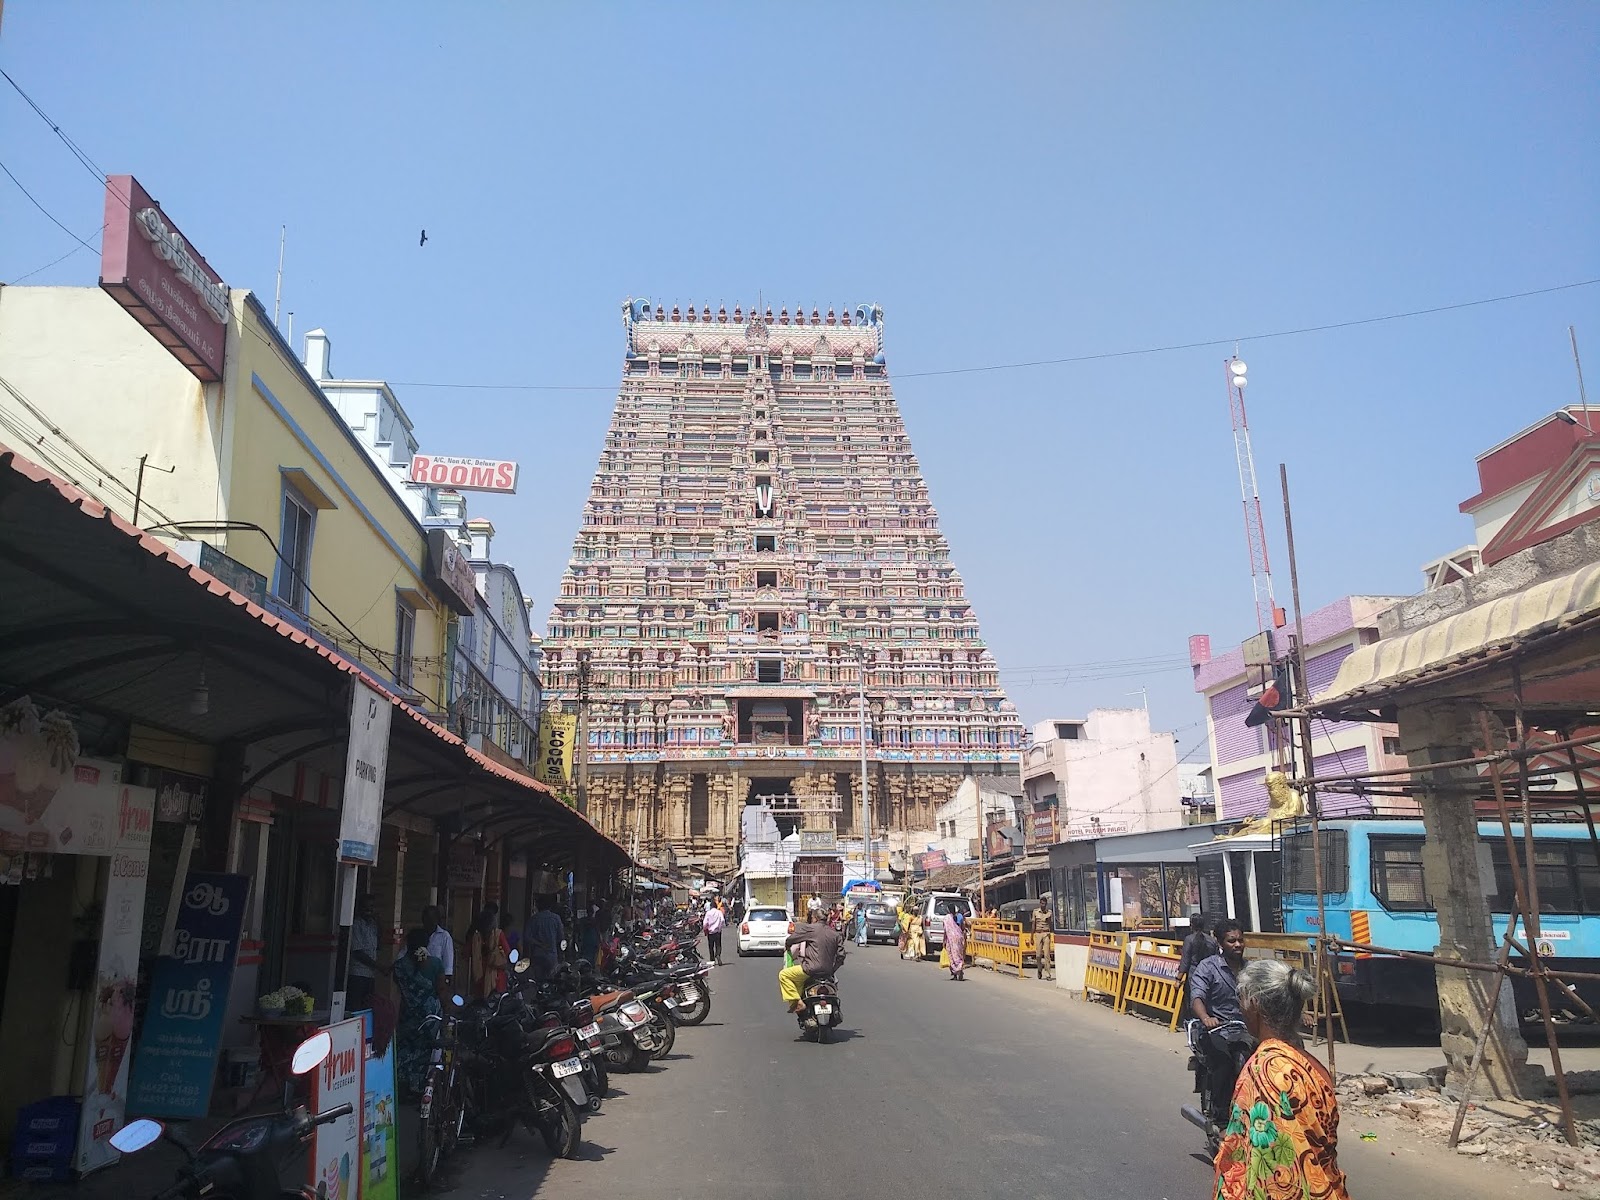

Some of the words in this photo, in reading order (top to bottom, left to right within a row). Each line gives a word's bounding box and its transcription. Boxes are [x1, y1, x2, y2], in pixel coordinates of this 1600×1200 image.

[412, 456, 513, 488] ROOMS
[447, 457, 460, 465] Non
[475, 459, 496, 467] Deluxe
[546, 730, 565, 775] ROOMS
[355, 759, 377, 784] PARKING
[1153, 960, 1164, 975] CITY
[324, 1047, 355, 1091] Arun
